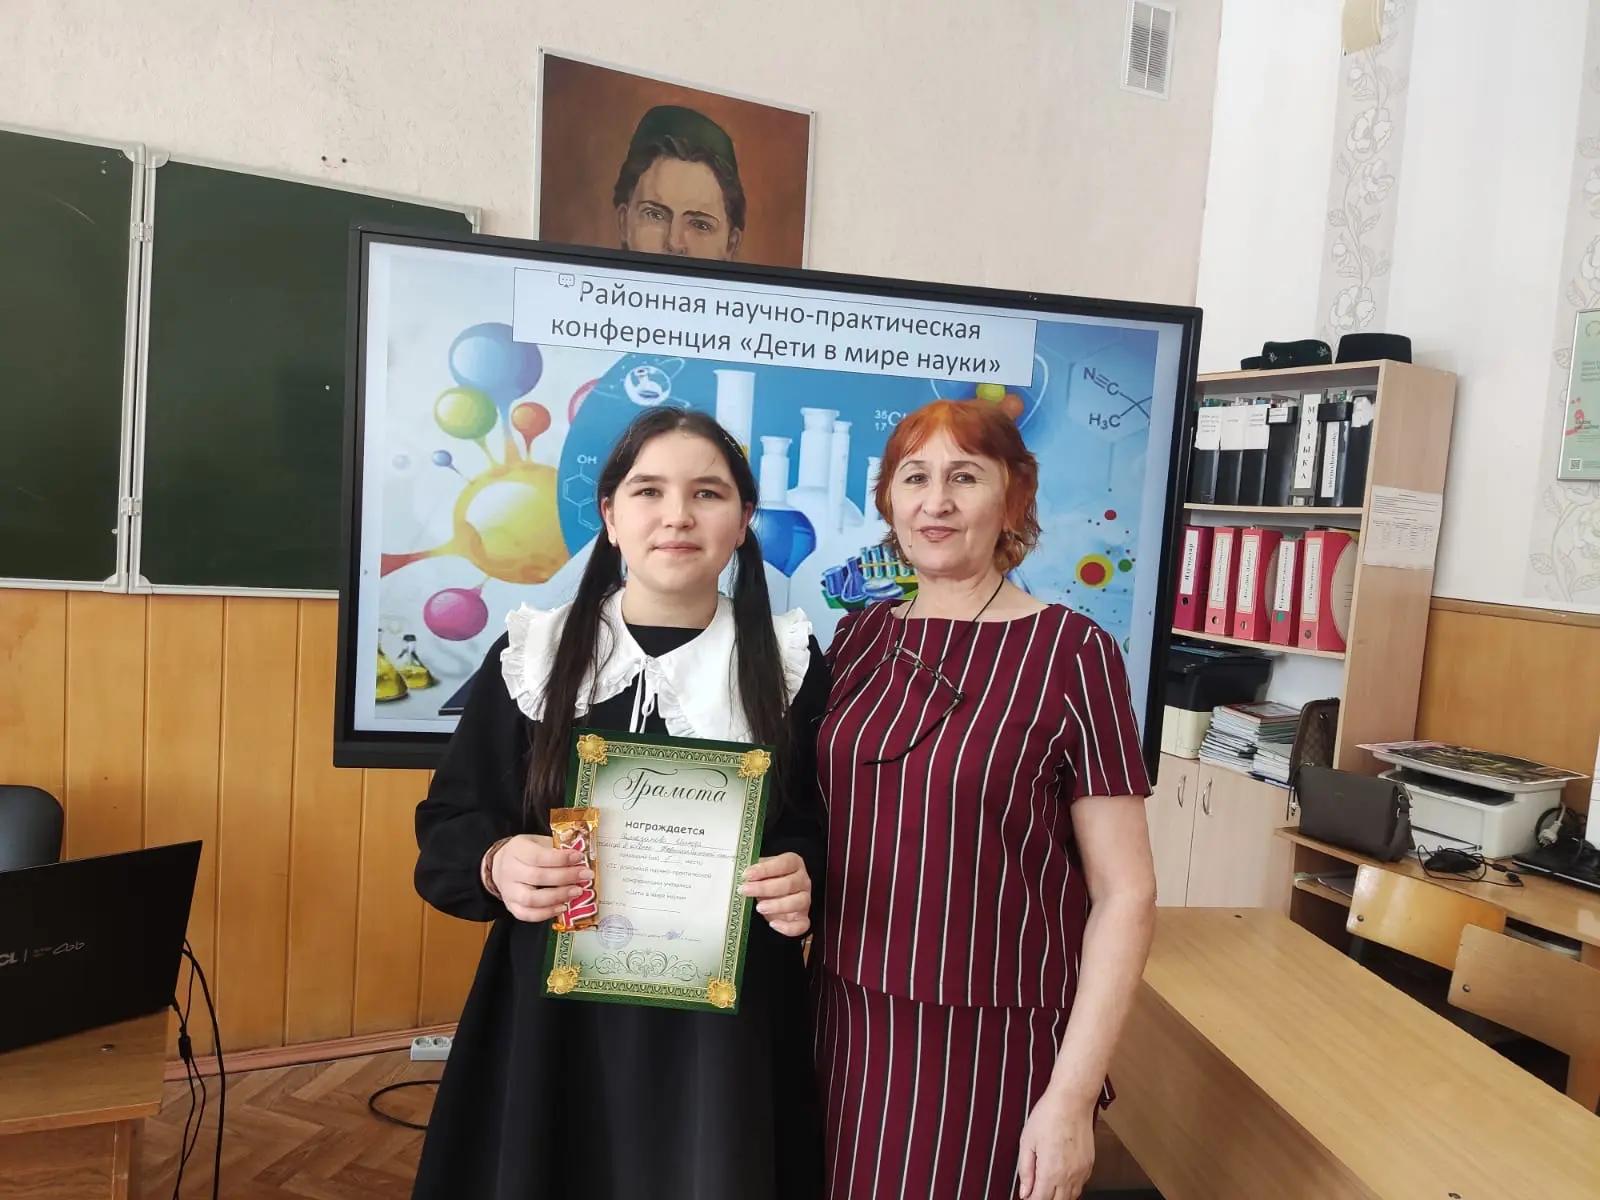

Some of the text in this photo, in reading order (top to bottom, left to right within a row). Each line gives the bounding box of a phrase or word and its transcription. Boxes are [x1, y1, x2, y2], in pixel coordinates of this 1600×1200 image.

[578, 280, 981, 341] Районная научно-практическая
[551, 317, 1002, 376] конференция «Дети в мире науки»
[577, 454, 597, 465] OH
[613, 767, 729, 811] Грамота
[625, 820, 705, 836] награждается
